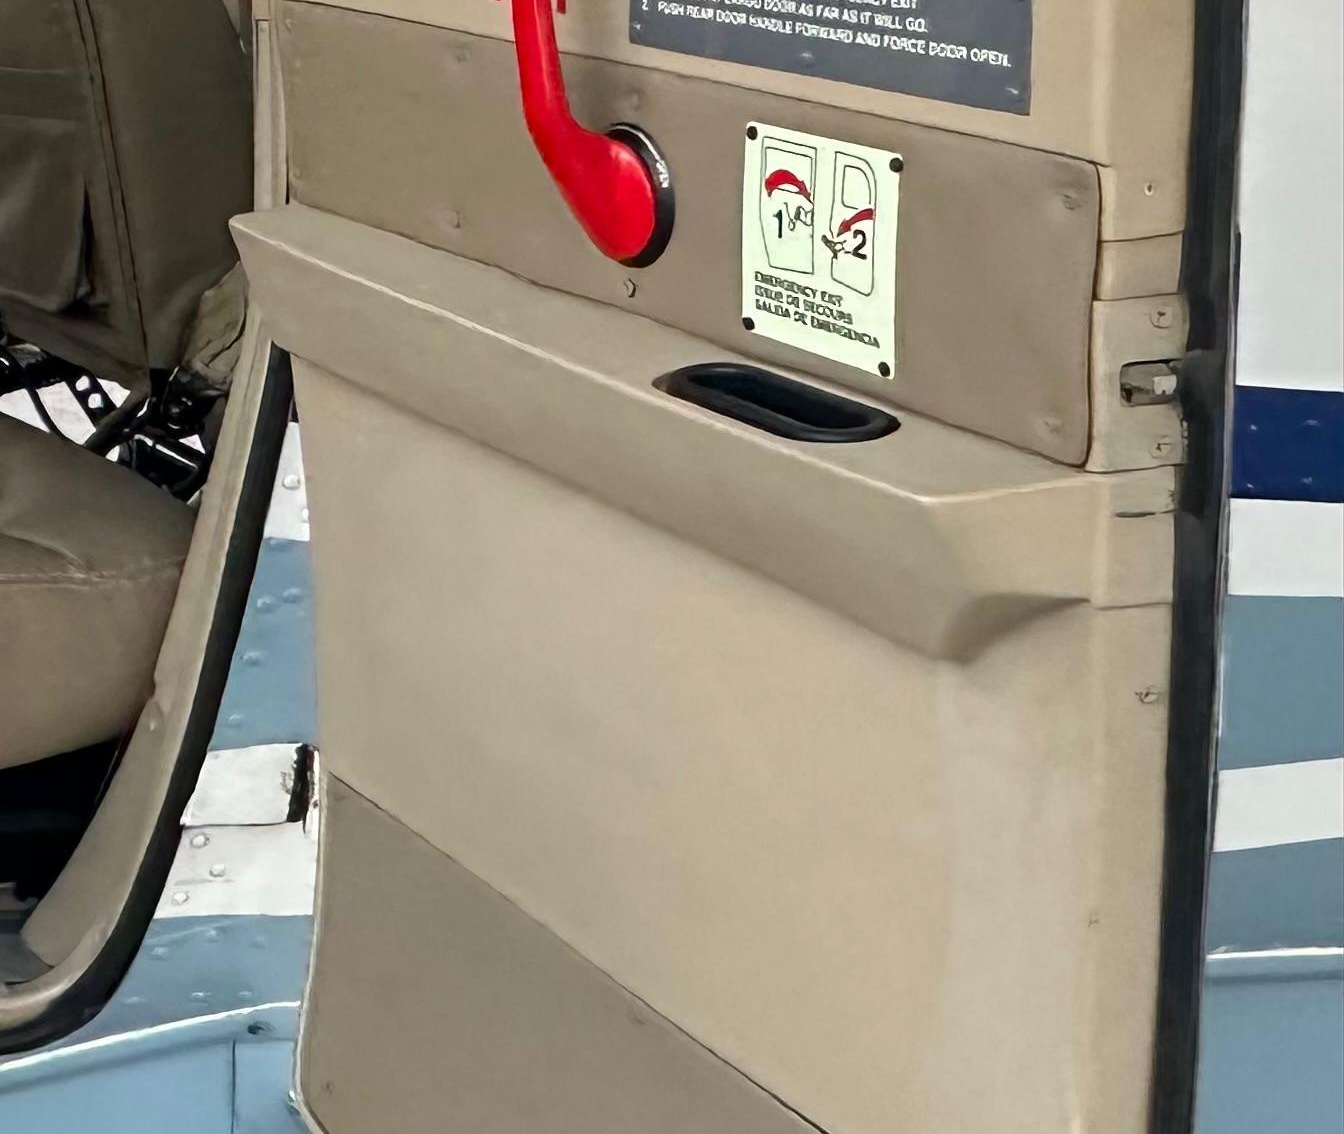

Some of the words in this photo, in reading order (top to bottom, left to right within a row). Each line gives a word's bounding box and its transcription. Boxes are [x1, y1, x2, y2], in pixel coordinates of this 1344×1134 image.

[798, 2, 814, 17] AS
[816, 4, 840, 20] FAR
[842, 8, 858, 23] AS
[860, 11, 873, 25] IT
[874, 13, 903, 29] WILL
[905, 17, 928, 33] GO.
[657, 0, 685, 16] PUSH
[686, 5, 714, 21] REAR
[716, 9, 747, 25] DOOR
[749, 13, 793, 34] HANDLE
[795, 21, 853, 44] FORWARD
[855, 31, 881, 47] AND
[883, 34, 926, 54] FORCE
[929, 41, 967, 60] DOOR
[970, 47, 1012, 67] OPEN.
[772, 209, 783, 239] 1
[852, 229, 868, 260] 2
[755, 271, 818, 299] EMERGENCY
[820, 291, 843, 308] EXIT
[755, 299, 791, 318] SALIDA
[793, 311, 808, 326] DE
[811, 316, 881, 349] EMERGENCIA
[803, 299, 854, 325] SECOURS
